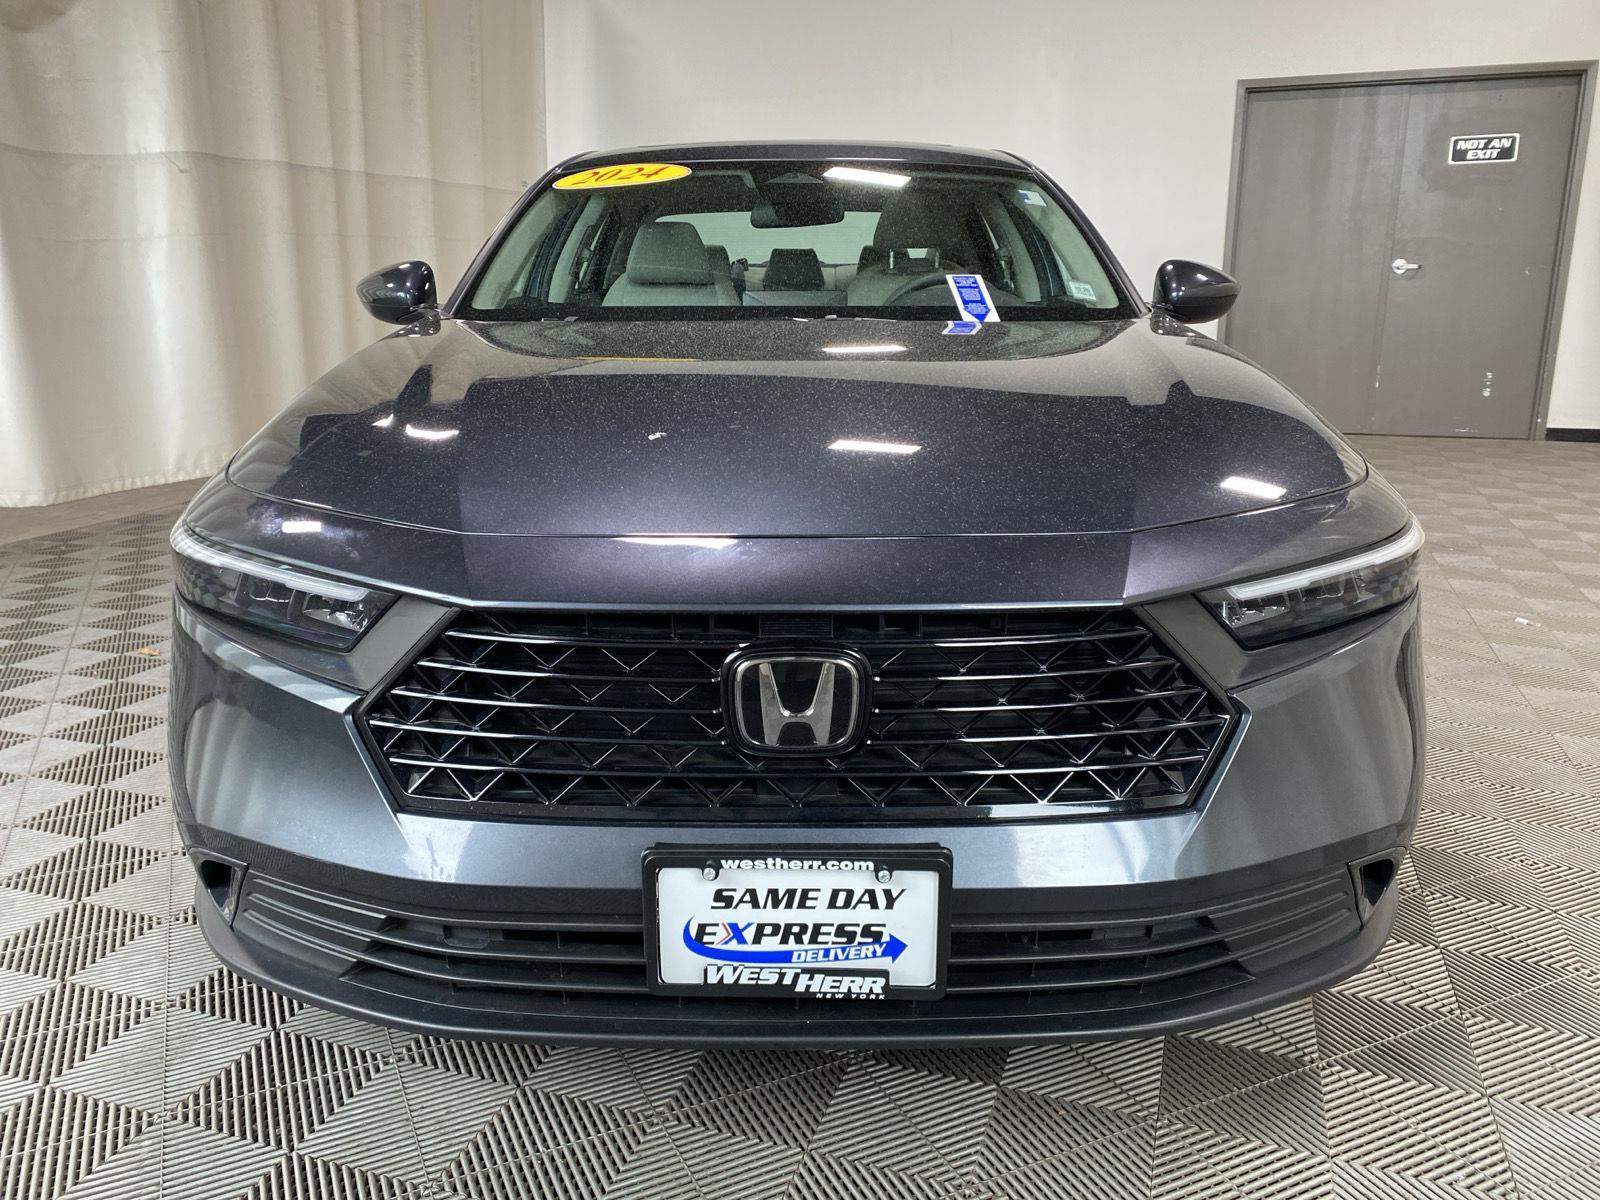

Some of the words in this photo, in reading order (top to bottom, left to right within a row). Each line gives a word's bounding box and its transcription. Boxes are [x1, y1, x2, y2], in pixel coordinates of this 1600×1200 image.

[1457, 139, 1488, 150] NOT
[1488, 137, 1513, 149] AN
[1466, 148, 1501, 160] EXIT
[571, 166, 670, 186] 2024
[720, 857, 875, 871] westherr.com
[710, 888, 822, 910] SAME
[826, 888, 907, 910] DAY
[694, 922, 887, 946] EXPRESS
[791, 943, 887, 963] DELIVERY
[816, 992, 844, 1000] NEW
